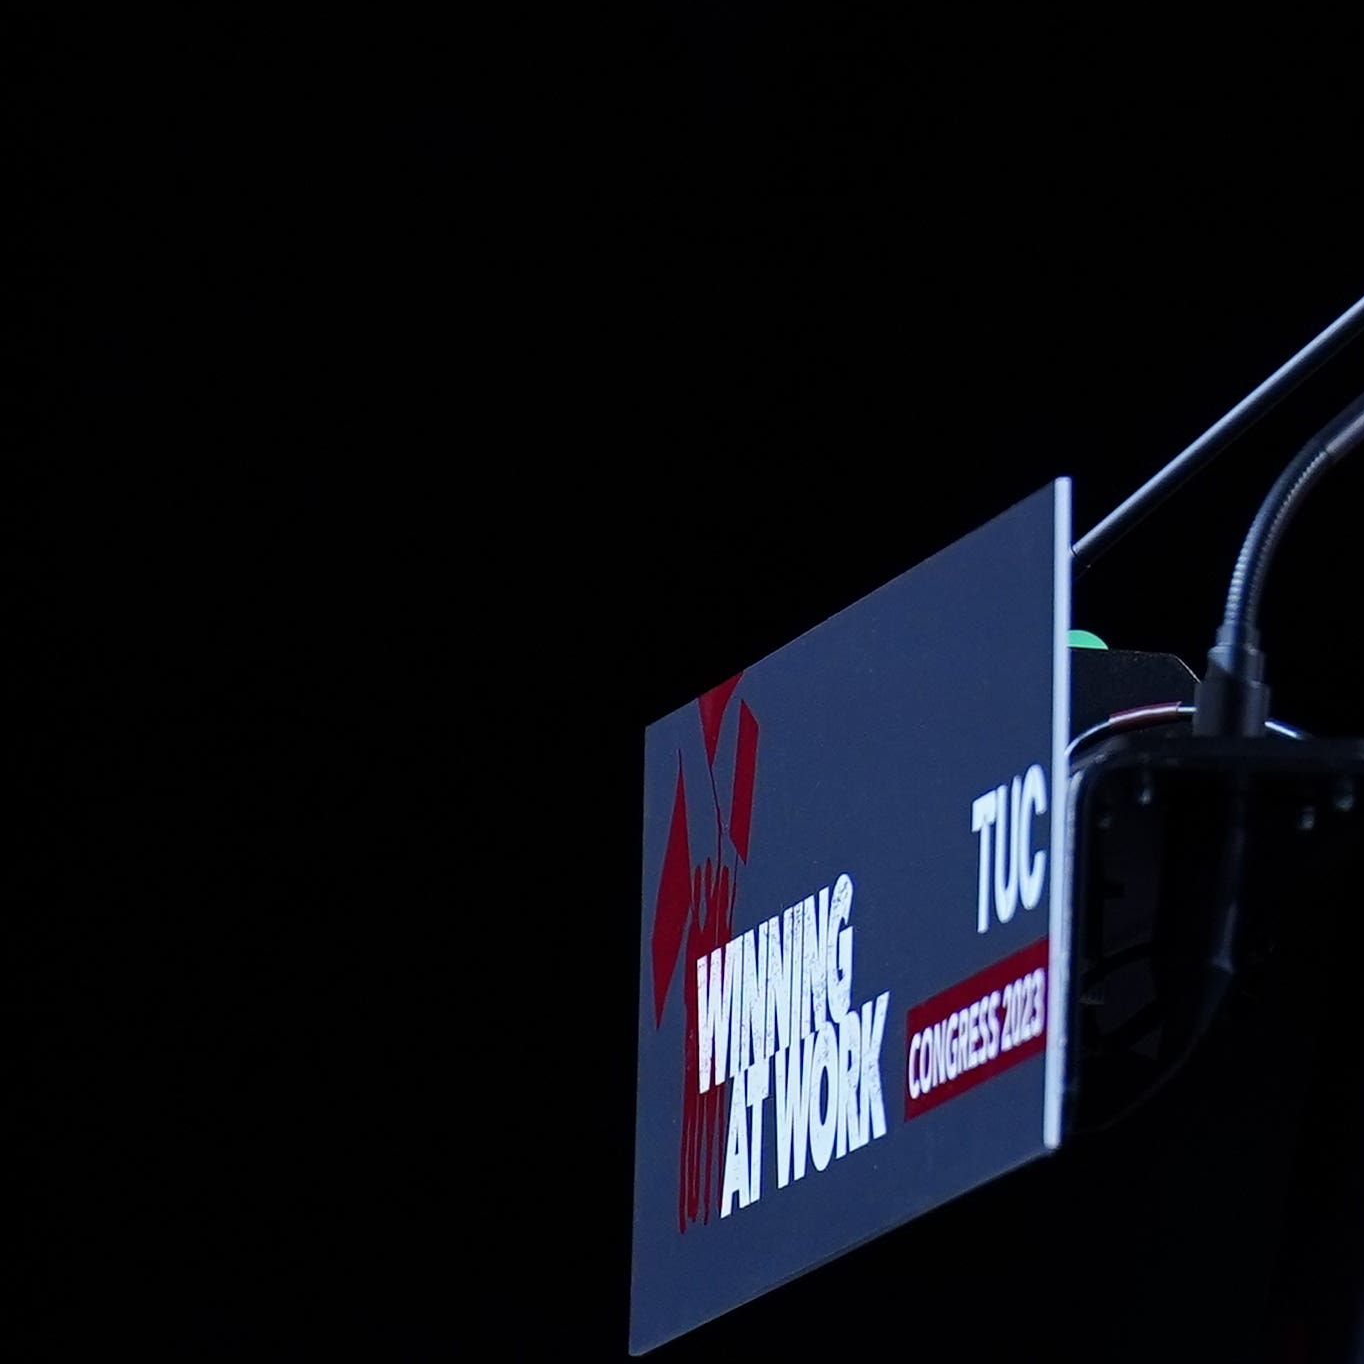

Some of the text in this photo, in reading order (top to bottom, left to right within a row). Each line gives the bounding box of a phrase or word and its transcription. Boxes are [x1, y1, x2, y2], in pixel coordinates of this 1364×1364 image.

[971, 763, 1047, 934] TUC
[696, 873, 853, 1095] WINNING
[908, 967, 1046, 1100] CONGRESS 2023
[720, 991, 890, 1219] AT WORK
